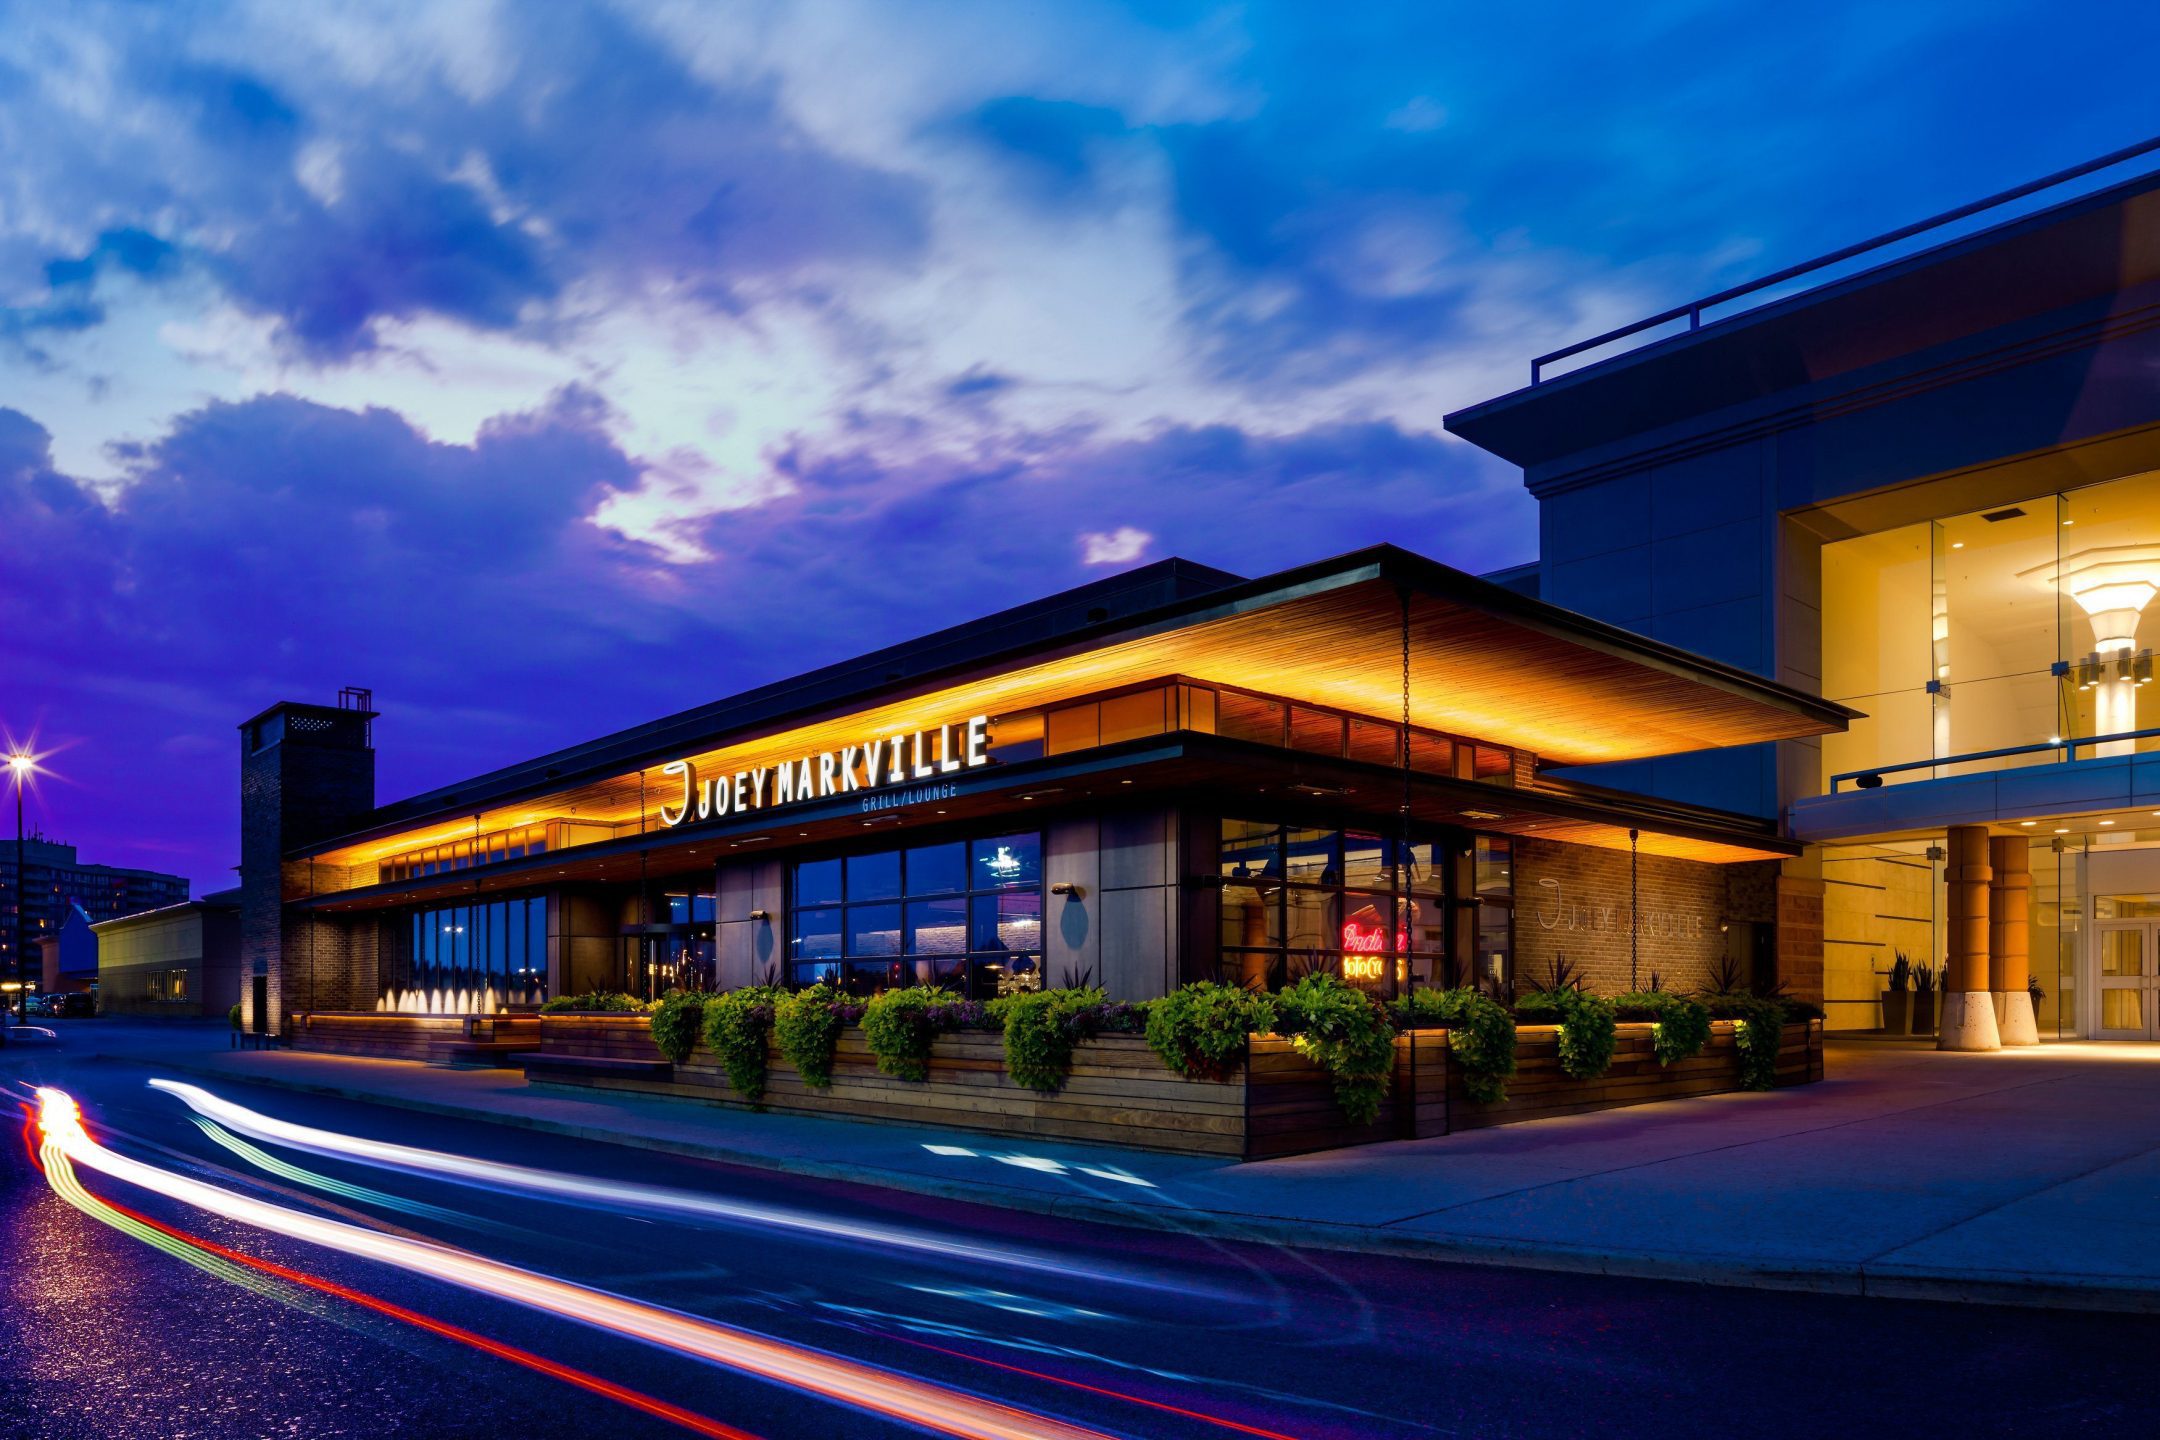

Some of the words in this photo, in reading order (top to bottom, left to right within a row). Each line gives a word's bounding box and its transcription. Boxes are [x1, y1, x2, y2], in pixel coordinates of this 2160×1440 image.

[698, 767, 768, 819] JOEY
[777, 715, 989, 804] MARKVILLE
[862, 783, 957, 812] GRILL/LOUNGE
[1568, 905, 1611, 933] JOEY
